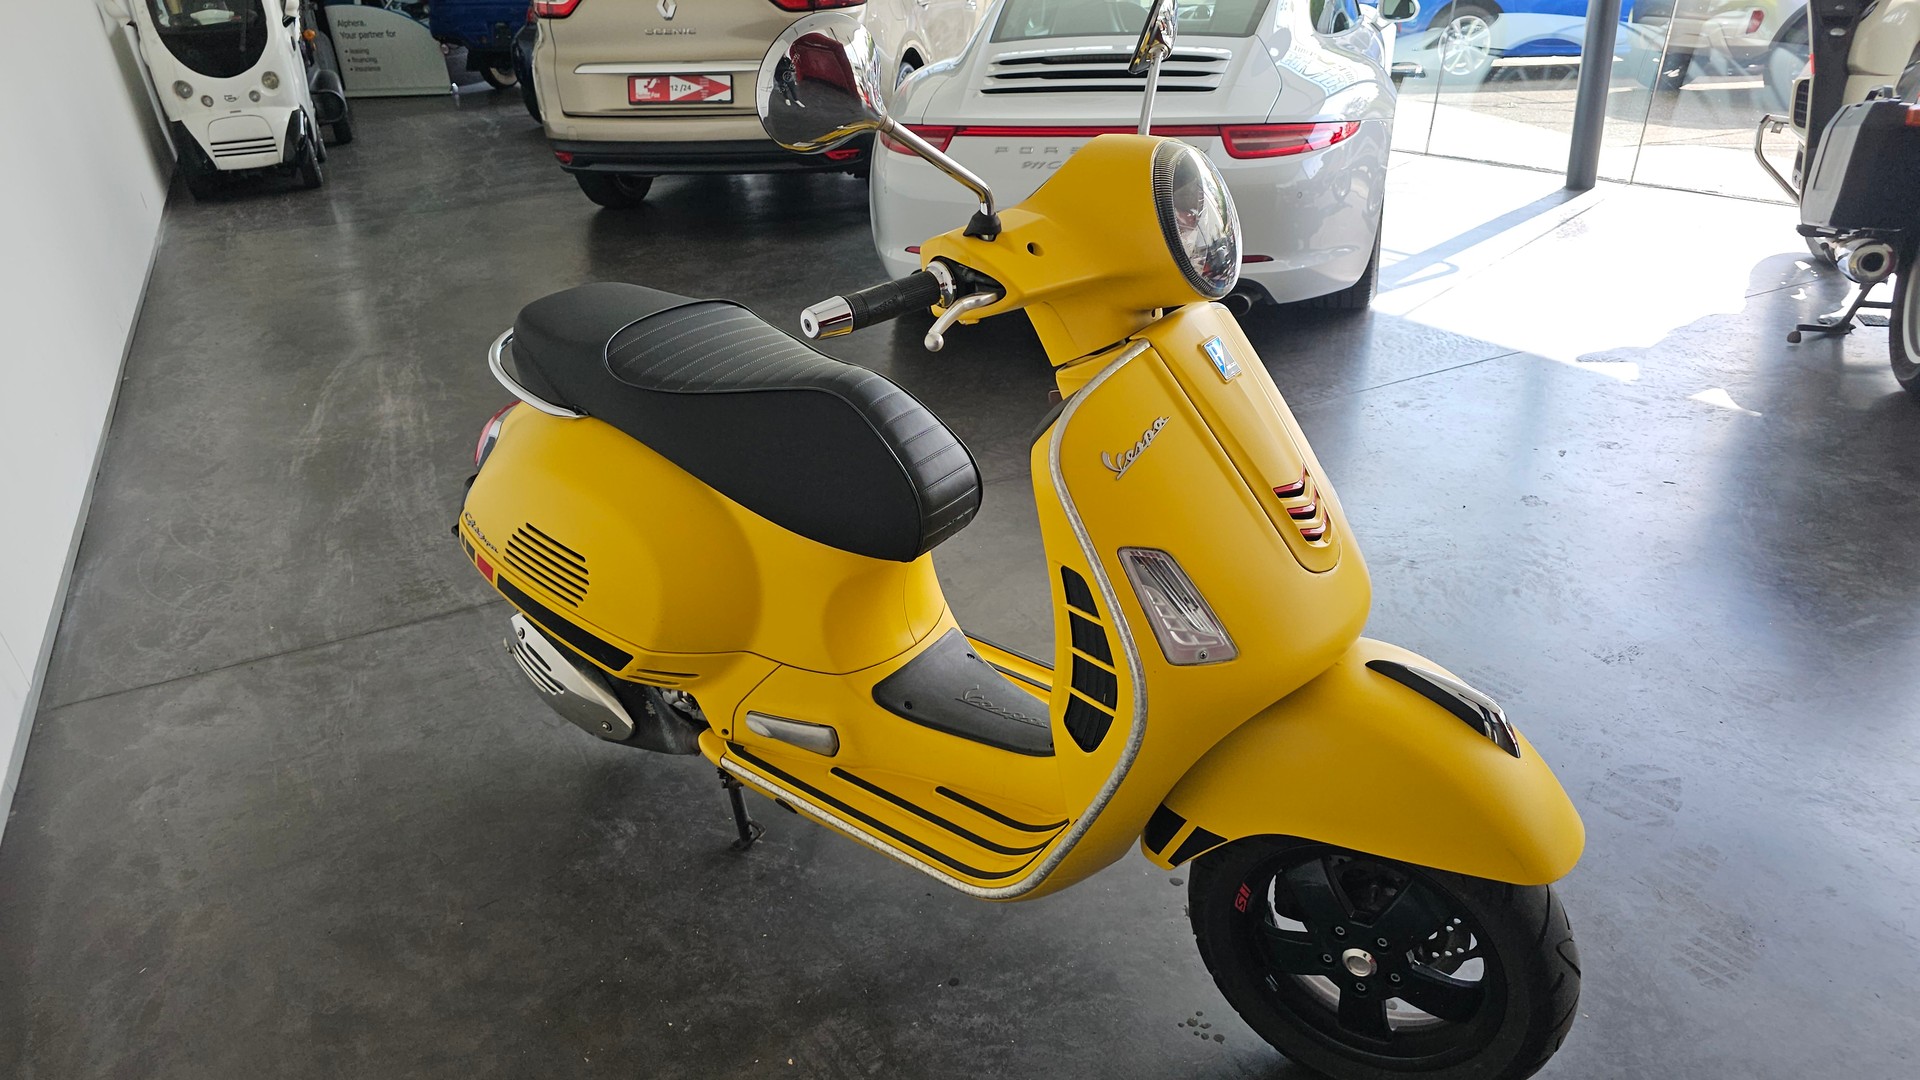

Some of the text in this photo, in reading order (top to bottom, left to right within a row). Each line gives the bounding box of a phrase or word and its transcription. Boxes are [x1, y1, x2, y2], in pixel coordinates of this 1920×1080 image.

[340, 29, 396, 40] Your partner for
[644, 28, 697, 36] SCENIC
[1101, 416, 1170, 480] Vespa
